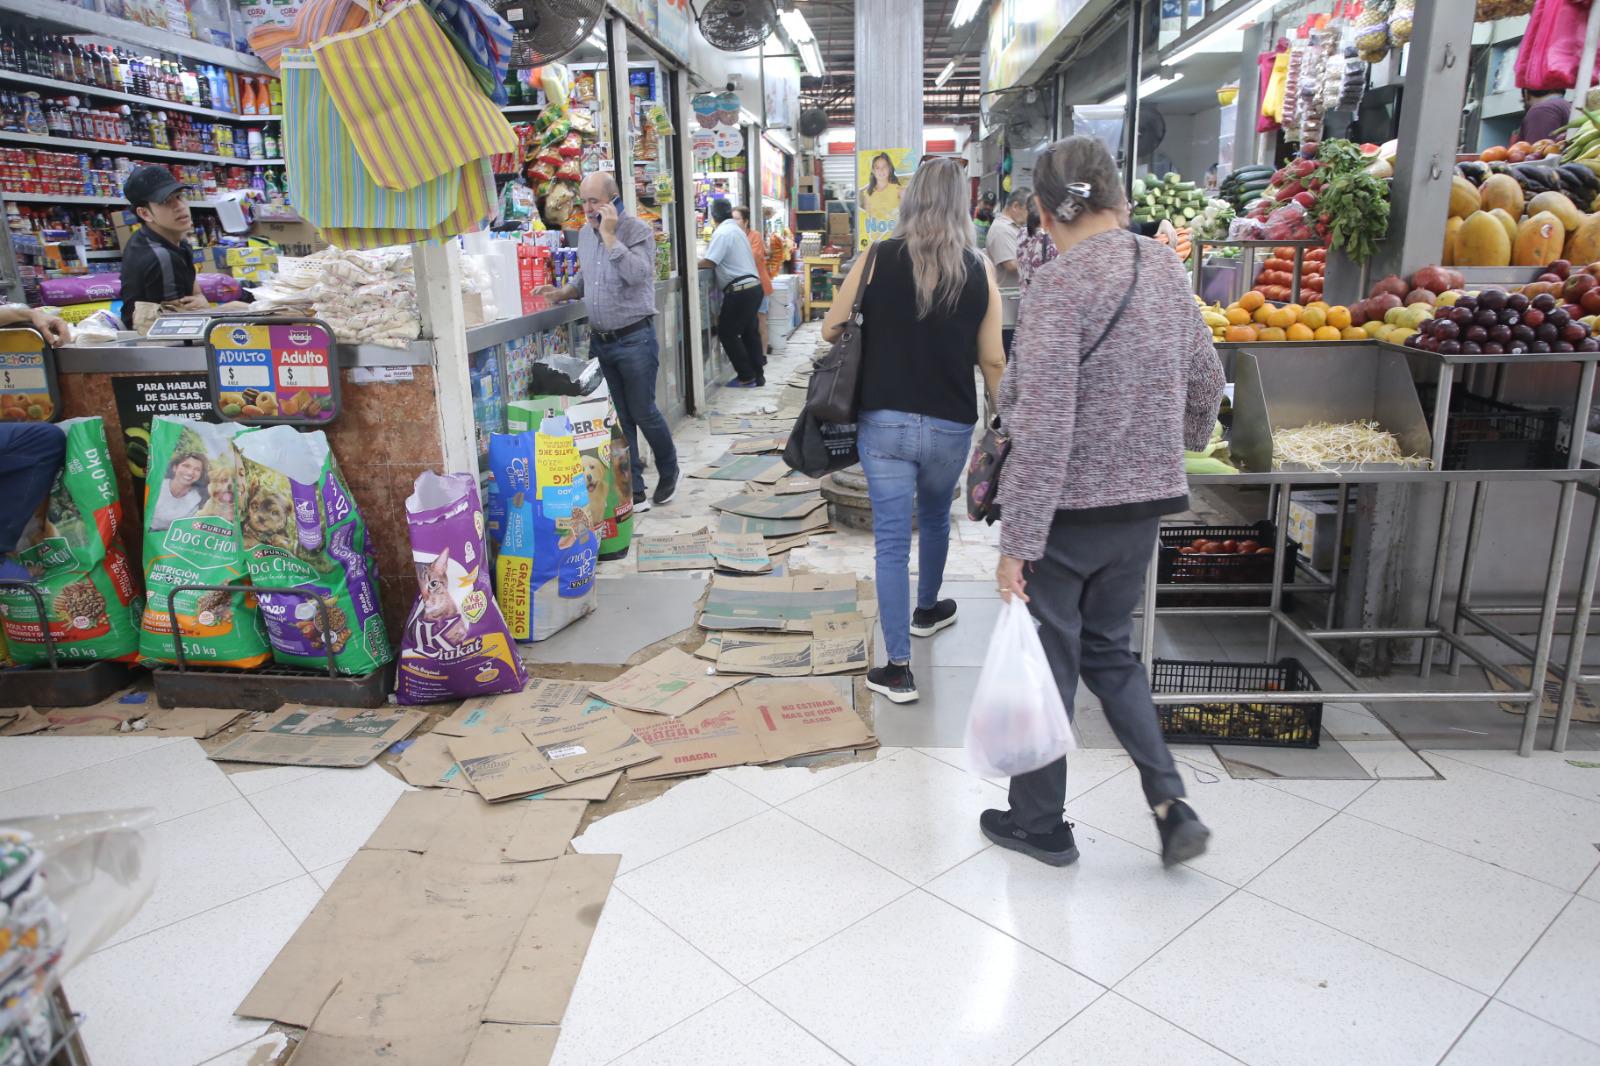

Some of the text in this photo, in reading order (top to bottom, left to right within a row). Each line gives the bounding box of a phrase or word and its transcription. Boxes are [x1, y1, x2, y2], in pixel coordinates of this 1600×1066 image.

[219, 350, 266, 363] ADULTO
[281, 351, 324, 364] Adulto
[137, 381, 207, 391] PARA HABLAR
[145, 393, 158, 401] DE
[136, 402, 213, 412] HAY QUE SABER
[202, 524, 232, 536] PURINA
[171, 529, 201, 546] DOG
[514, 562, 529, 634] GRATIS 3KG
[203, 646, 217, 657] kg
[438, 638, 482, 660] lukat
[782, 704, 794, 712] NO
[808, 709, 817, 717] DE
[818, 705, 843, 715] OCHO
